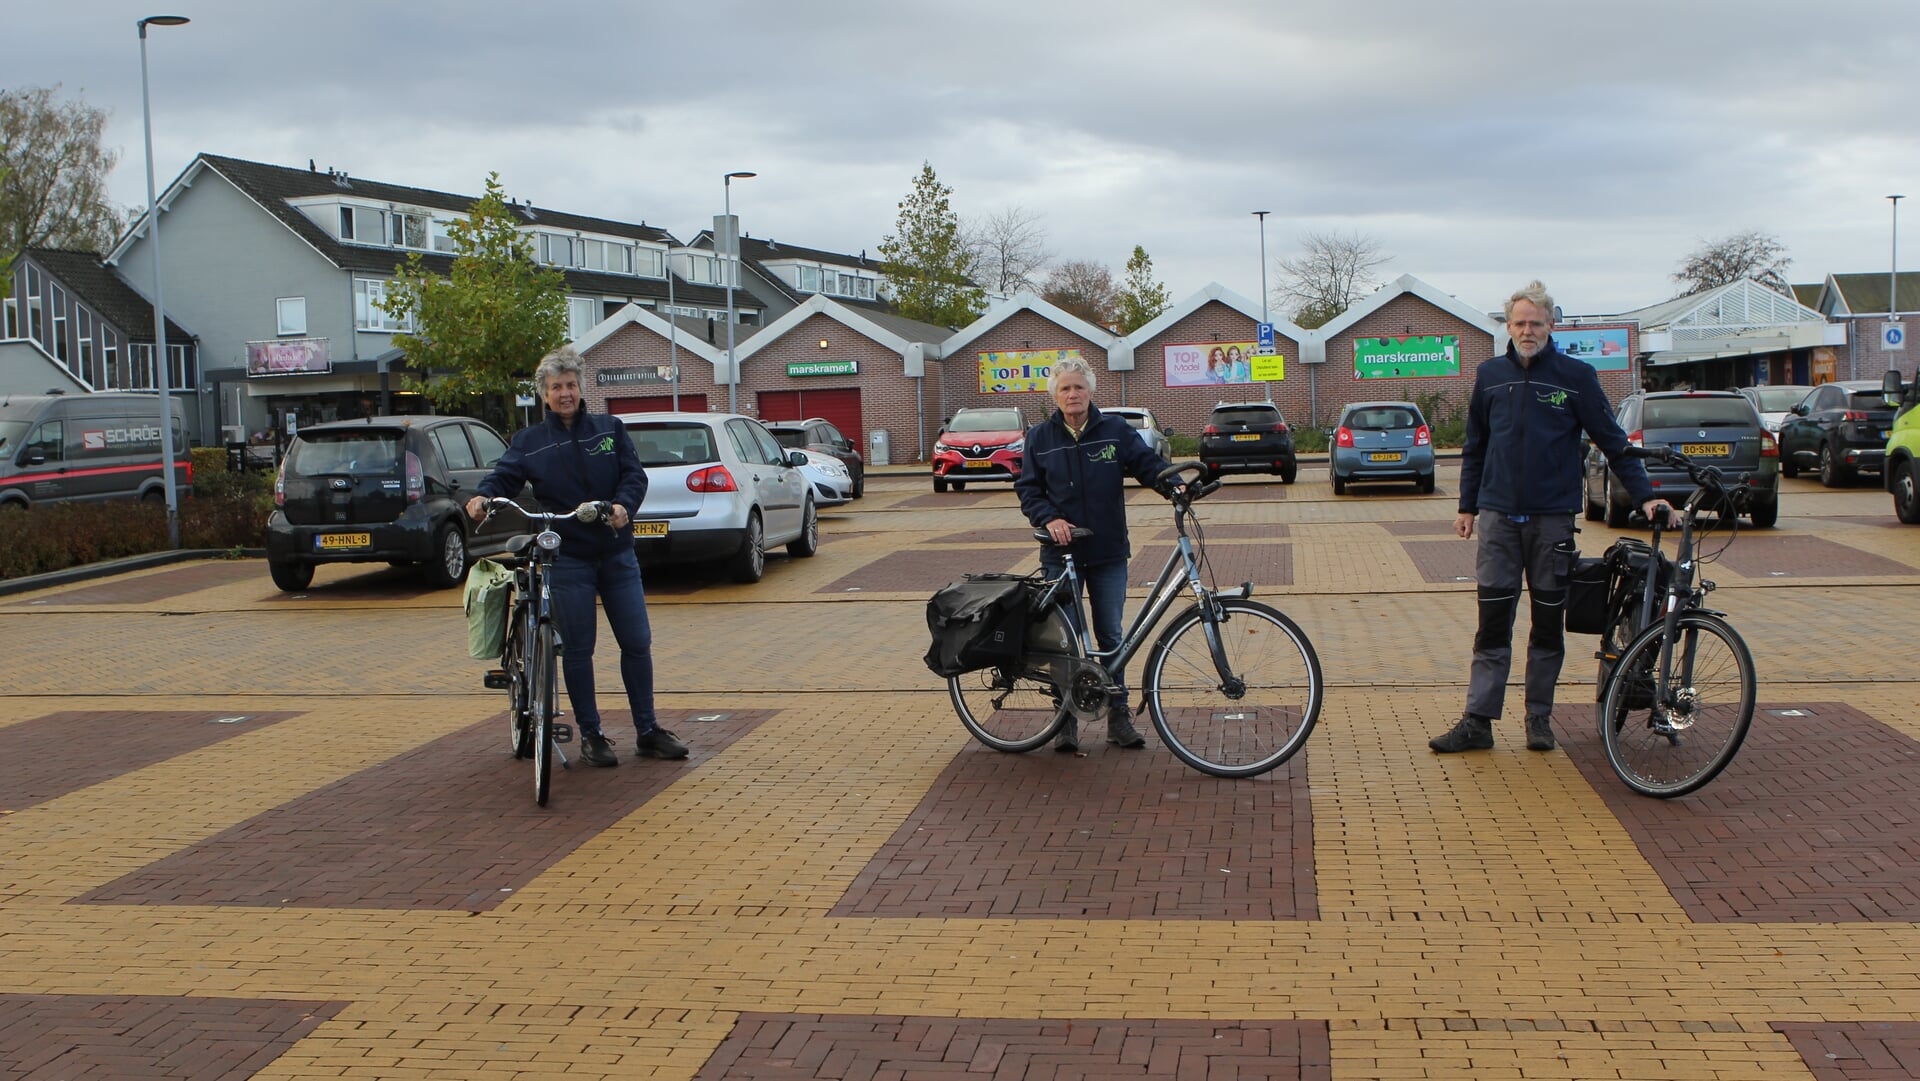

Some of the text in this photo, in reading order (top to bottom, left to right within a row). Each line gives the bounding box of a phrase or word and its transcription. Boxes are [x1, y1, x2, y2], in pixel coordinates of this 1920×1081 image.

[1261, 325, 1271, 338] P
[1174, 352, 1200, 363] TOP
[1363, 351, 1445, 364] marskramer
[790, 364, 849, 374] marskramer
[991, 364, 1051, 379] TOP 1 TO
[1174, 362, 1200, 371] Model
[105, 424, 163, 443] SCHRÖE
[1683, 445, 1727, 454] 80-SNK-4
[633, 523, 665, 534] RH-NZ
[322, 534, 368, 546] 49-HNL-8
